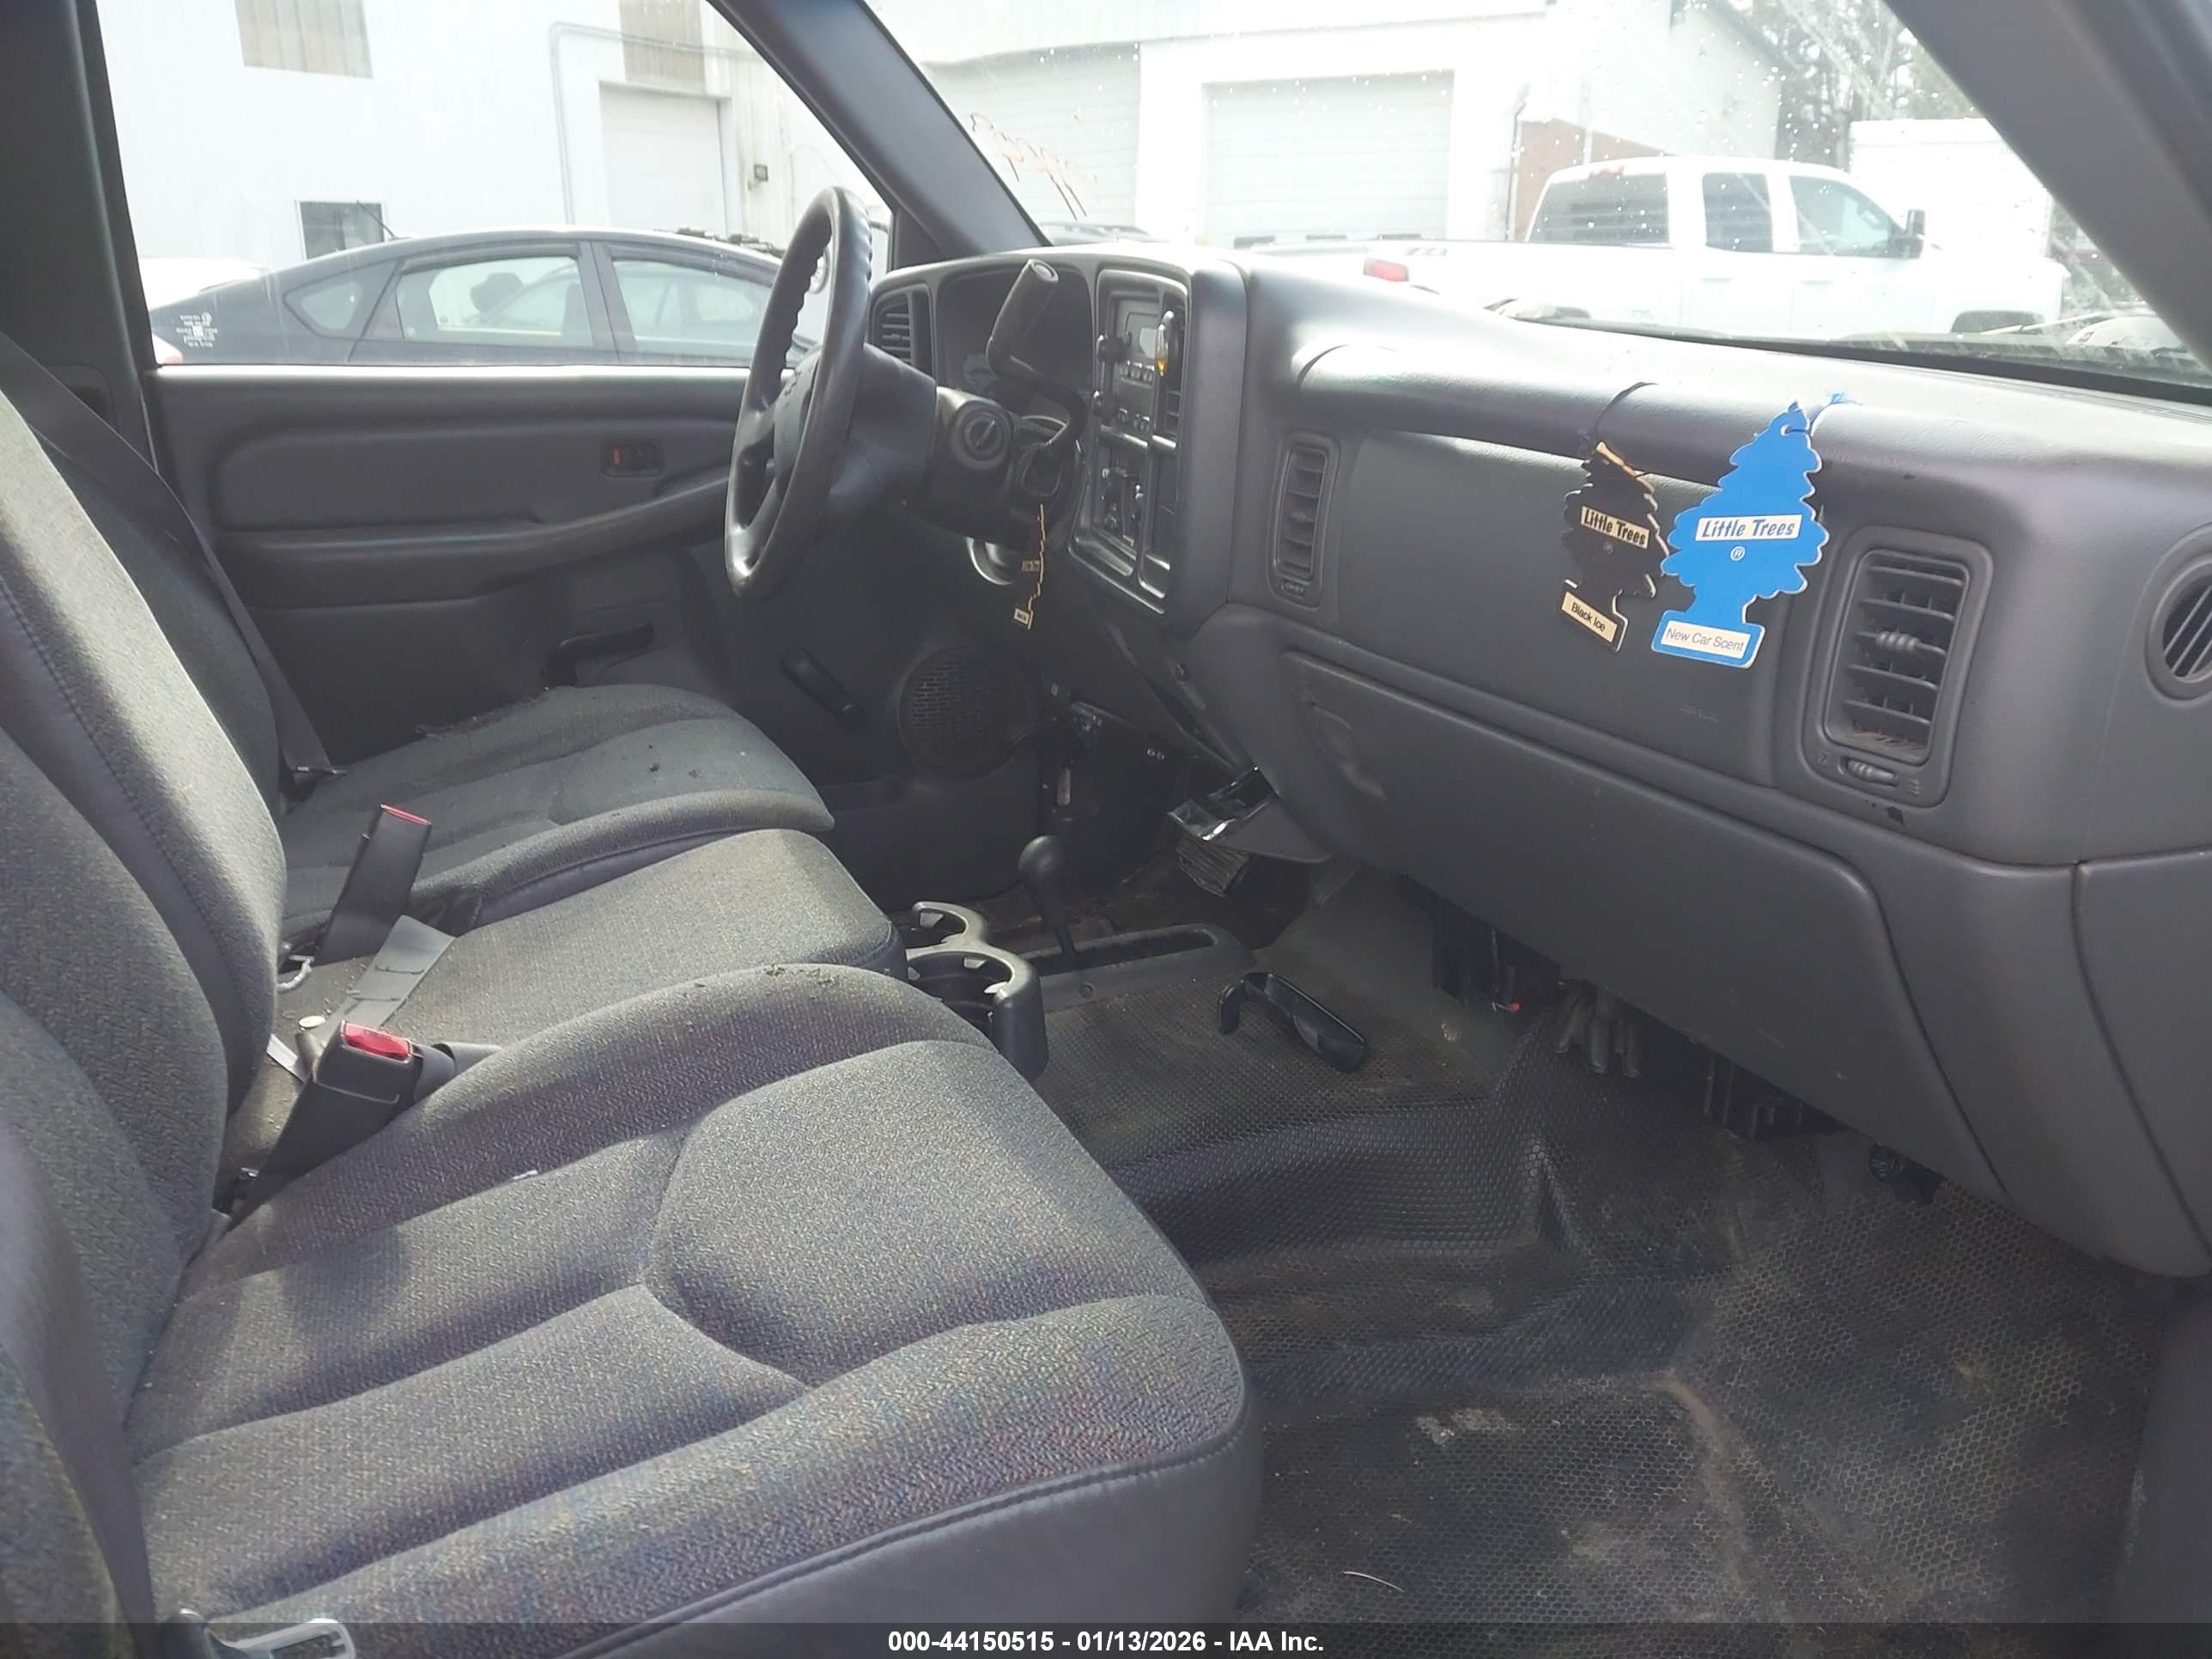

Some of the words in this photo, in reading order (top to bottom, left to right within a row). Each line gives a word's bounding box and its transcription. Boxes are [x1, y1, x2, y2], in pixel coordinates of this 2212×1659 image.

[1584, 508, 1613, 533] Little
[1616, 520, 1646, 545] Trees
[1701, 519, 1747, 538] Little
[1752, 519, 1796, 537] Trees
[1571, 602, 1593, 624] Black
[1593, 617, 1606, 632] Ice
[1666, 628, 1691, 641] New
[1692, 632, 1712, 646] Car
[1713, 635, 1745, 652] Scent
